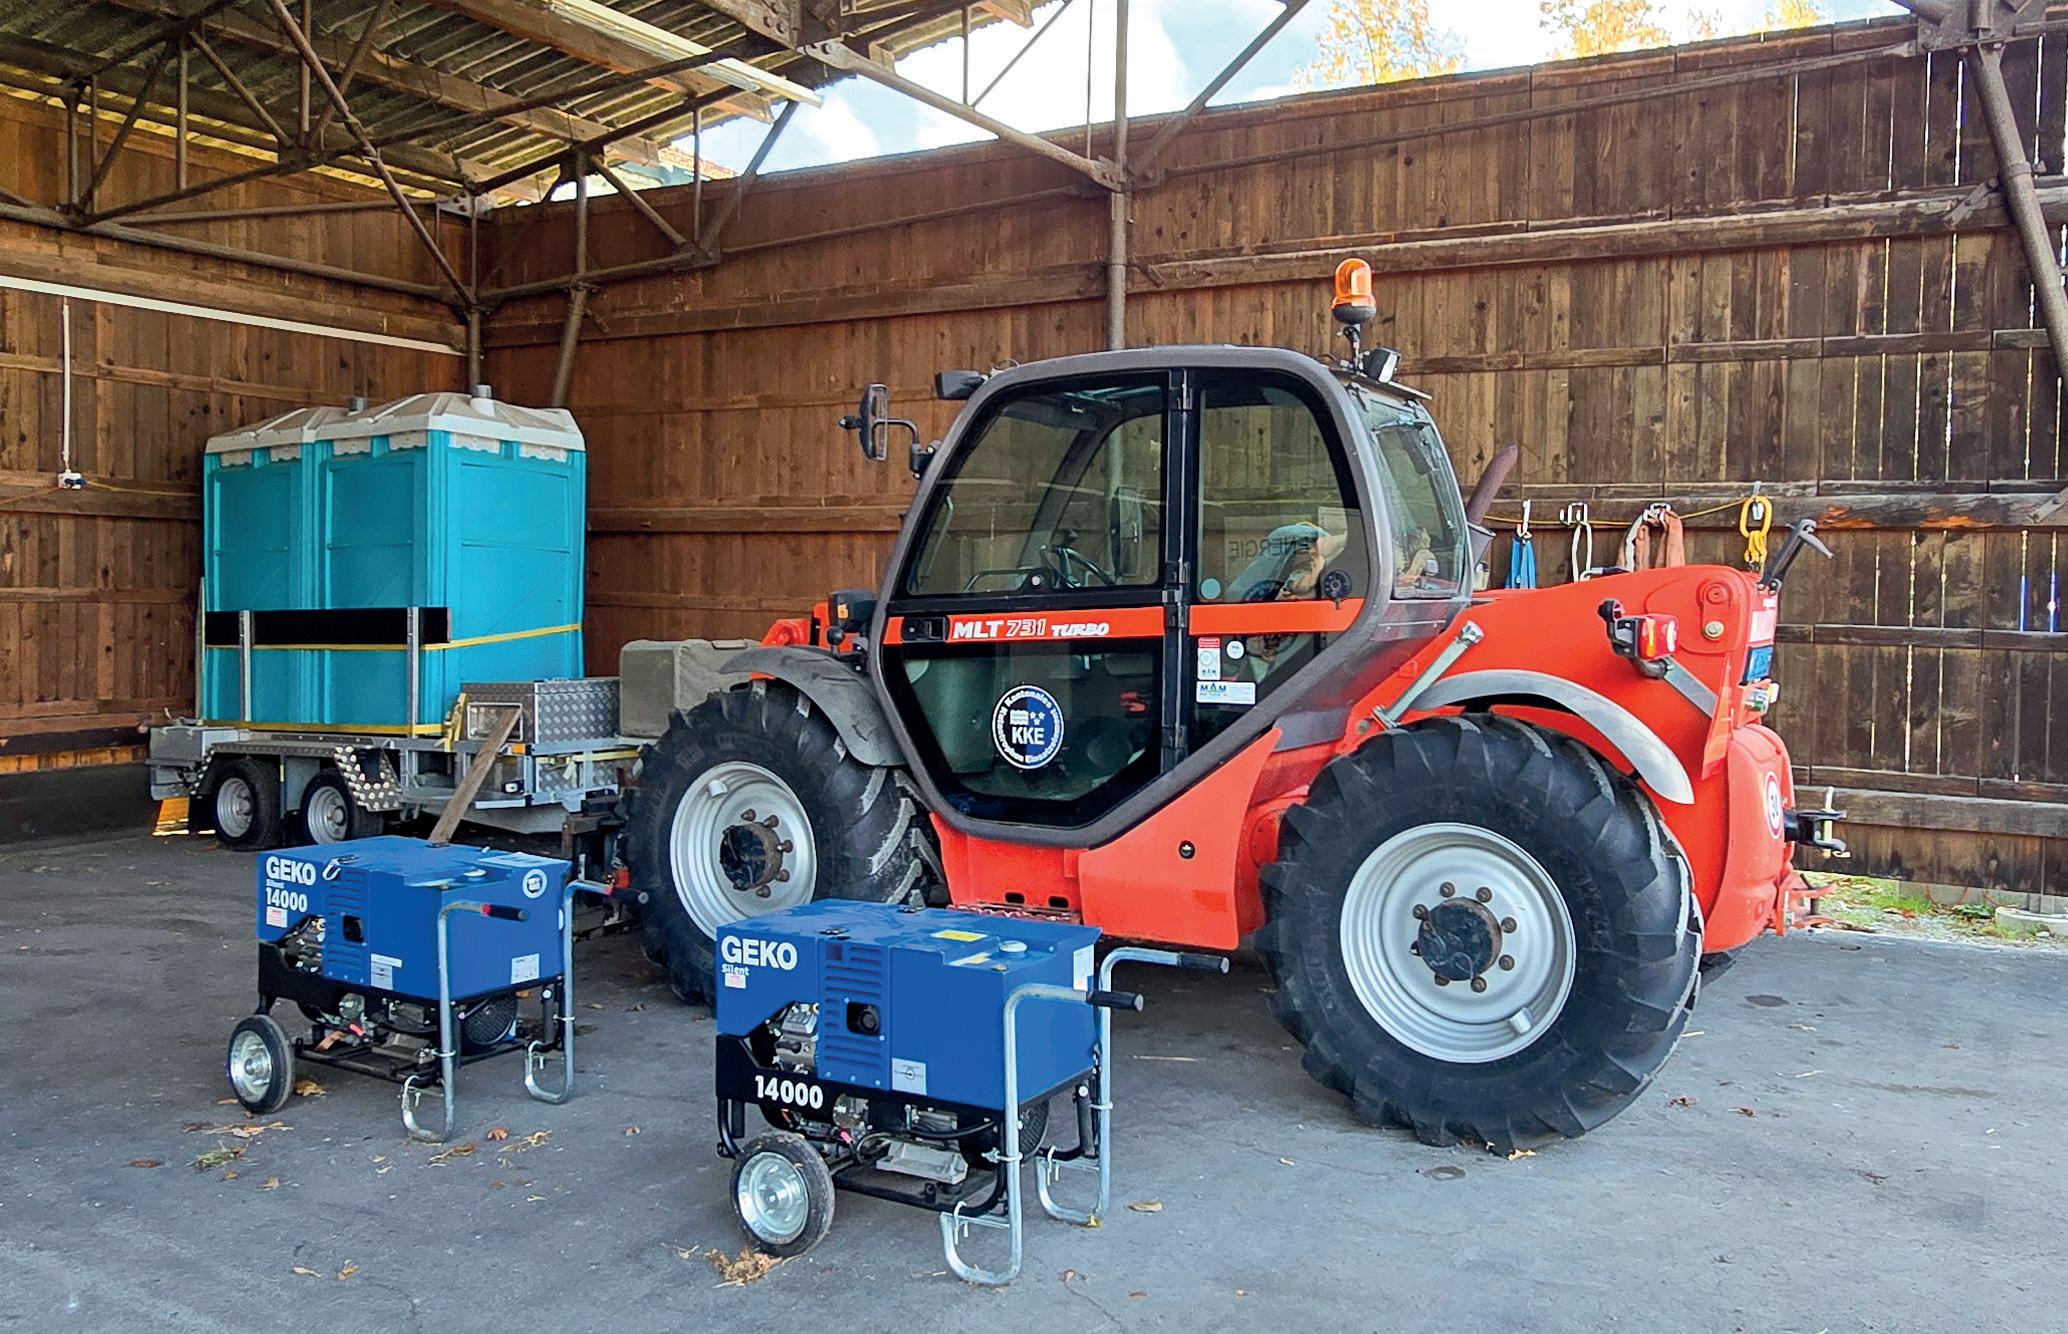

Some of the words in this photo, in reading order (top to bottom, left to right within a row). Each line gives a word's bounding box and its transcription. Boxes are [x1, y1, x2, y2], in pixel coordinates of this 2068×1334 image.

[952, 619, 1004, 639] MLT
[1005, 618, 1048, 636] 731
[1051, 622, 1109, 637] TURBO
[1011, 726, 1046, 746] KKE
[266, 855, 317, 886] GEKO
[265, 886, 308, 913] 14000
[720, 934, 798, 971] GEKO
[720, 963, 750, 976] Silent
[754, 1074, 824, 1110] 14000
